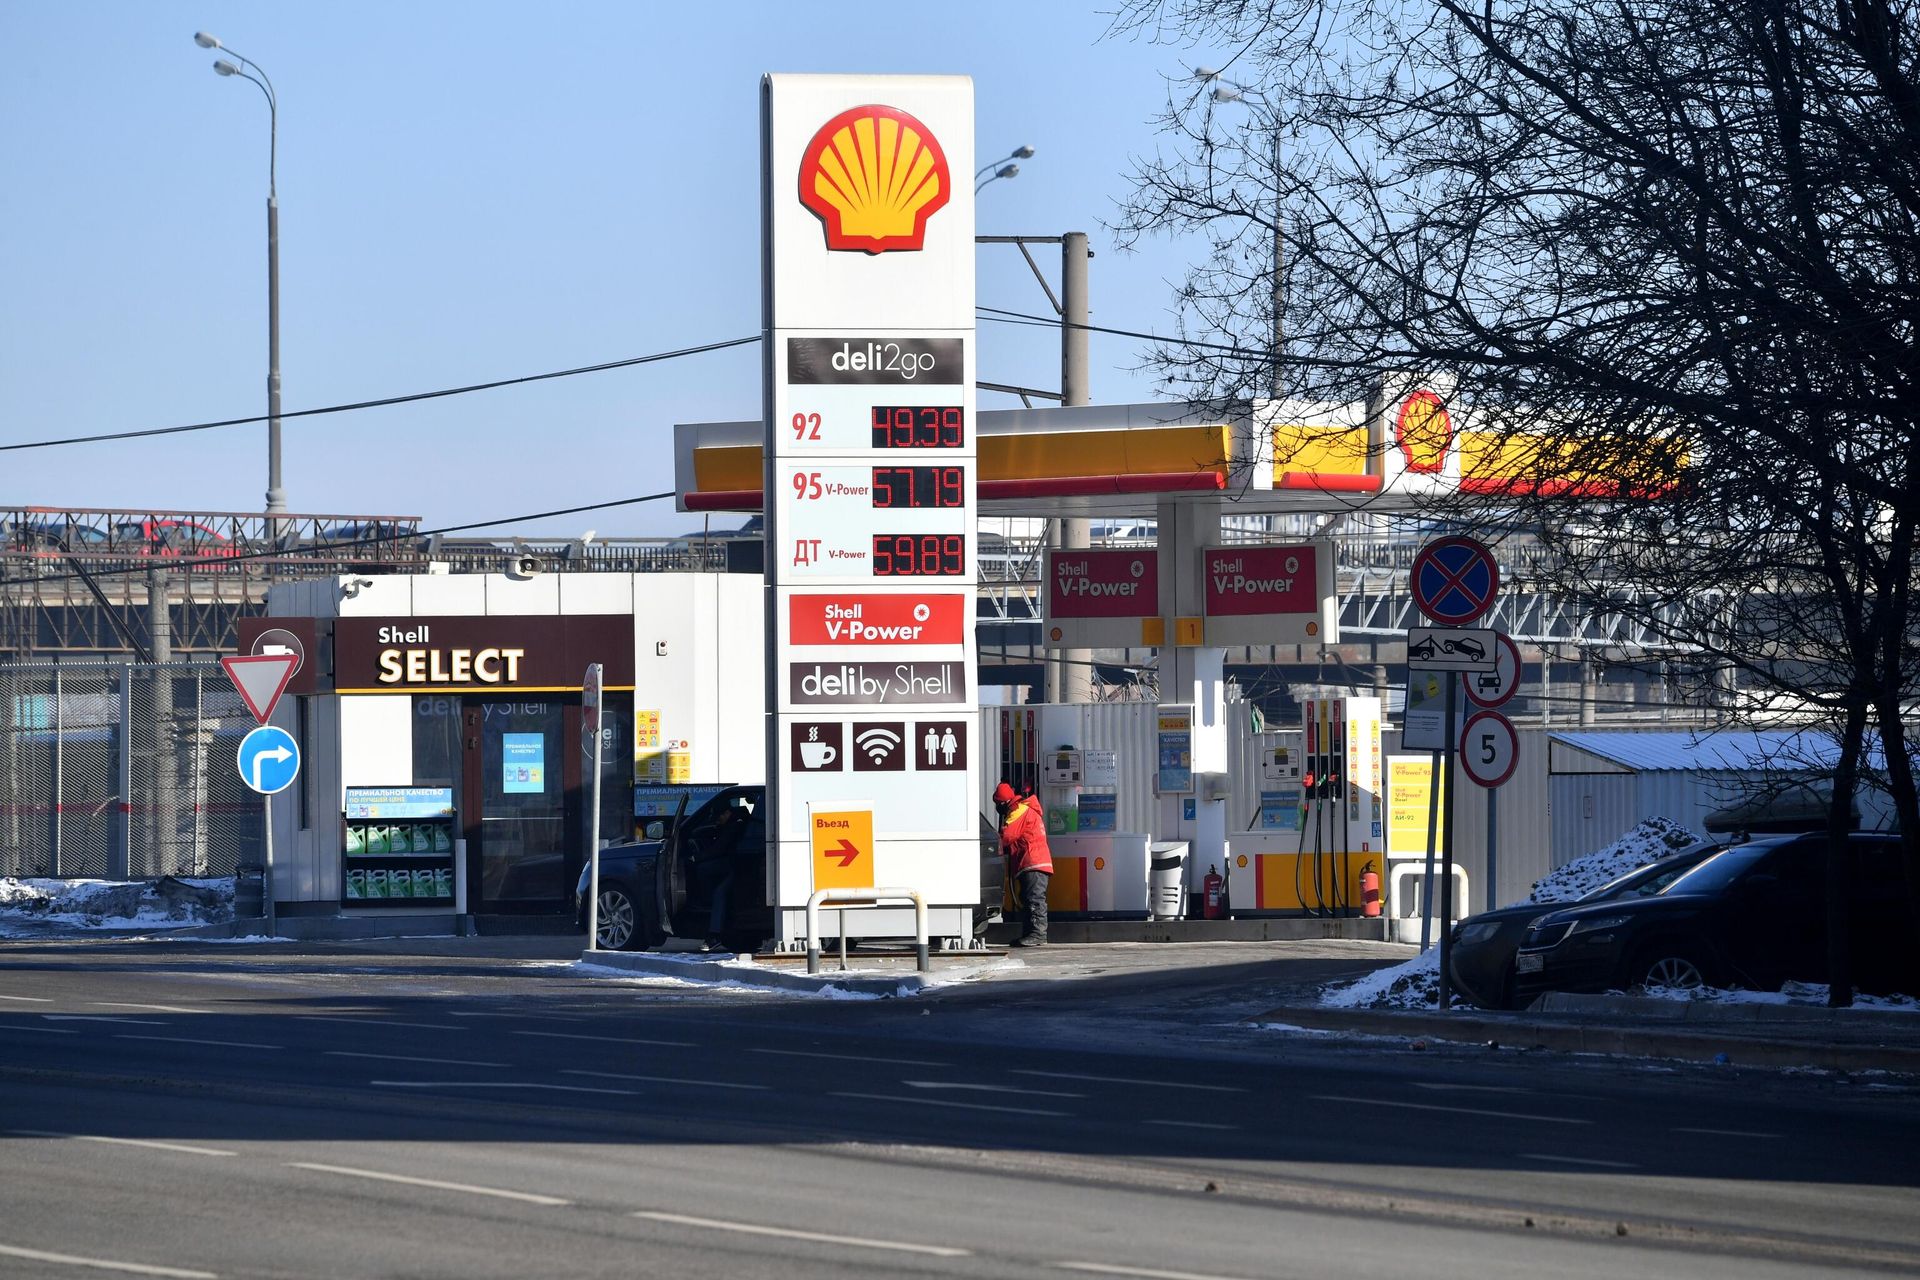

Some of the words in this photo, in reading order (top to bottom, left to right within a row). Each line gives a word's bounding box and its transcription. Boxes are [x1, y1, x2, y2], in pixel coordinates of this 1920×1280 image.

[832, 343, 935, 379] deli2go
[792, 413, 822, 440] 92
[872, 408, 963, 447] 49.39
[793, 472, 822, 500] 95
[825, 483, 869, 496] V-Power
[872, 468, 963, 507] 57.19
[794, 539, 822, 567] ДТ
[829, 549, 866, 559] V-Power
[873, 536, 963, 575] 59.89
[1058, 561, 1088, 576] Shell
[1212, 558, 1243, 574] Shell
[1058, 578, 1139, 596] V-Power
[1213, 575, 1294, 594] V-Power
[825, 604, 862, 619] Shell
[378, 626, 430, 644] Shell
[825, 621, 923, 640] V-Power
[1189, 623, 1196, 640] 1
[378, 648, 525, 684] SELECT
[801, 666, 856, 697] deli
[860, 666, 890, 703] by
[894, 665, 951, 695] Shell
[1481, 734, 1496, 764] 5
[693, 786, 726, 794] КАЧЕСТВ
[816, 818, 850, 830] Въезд
